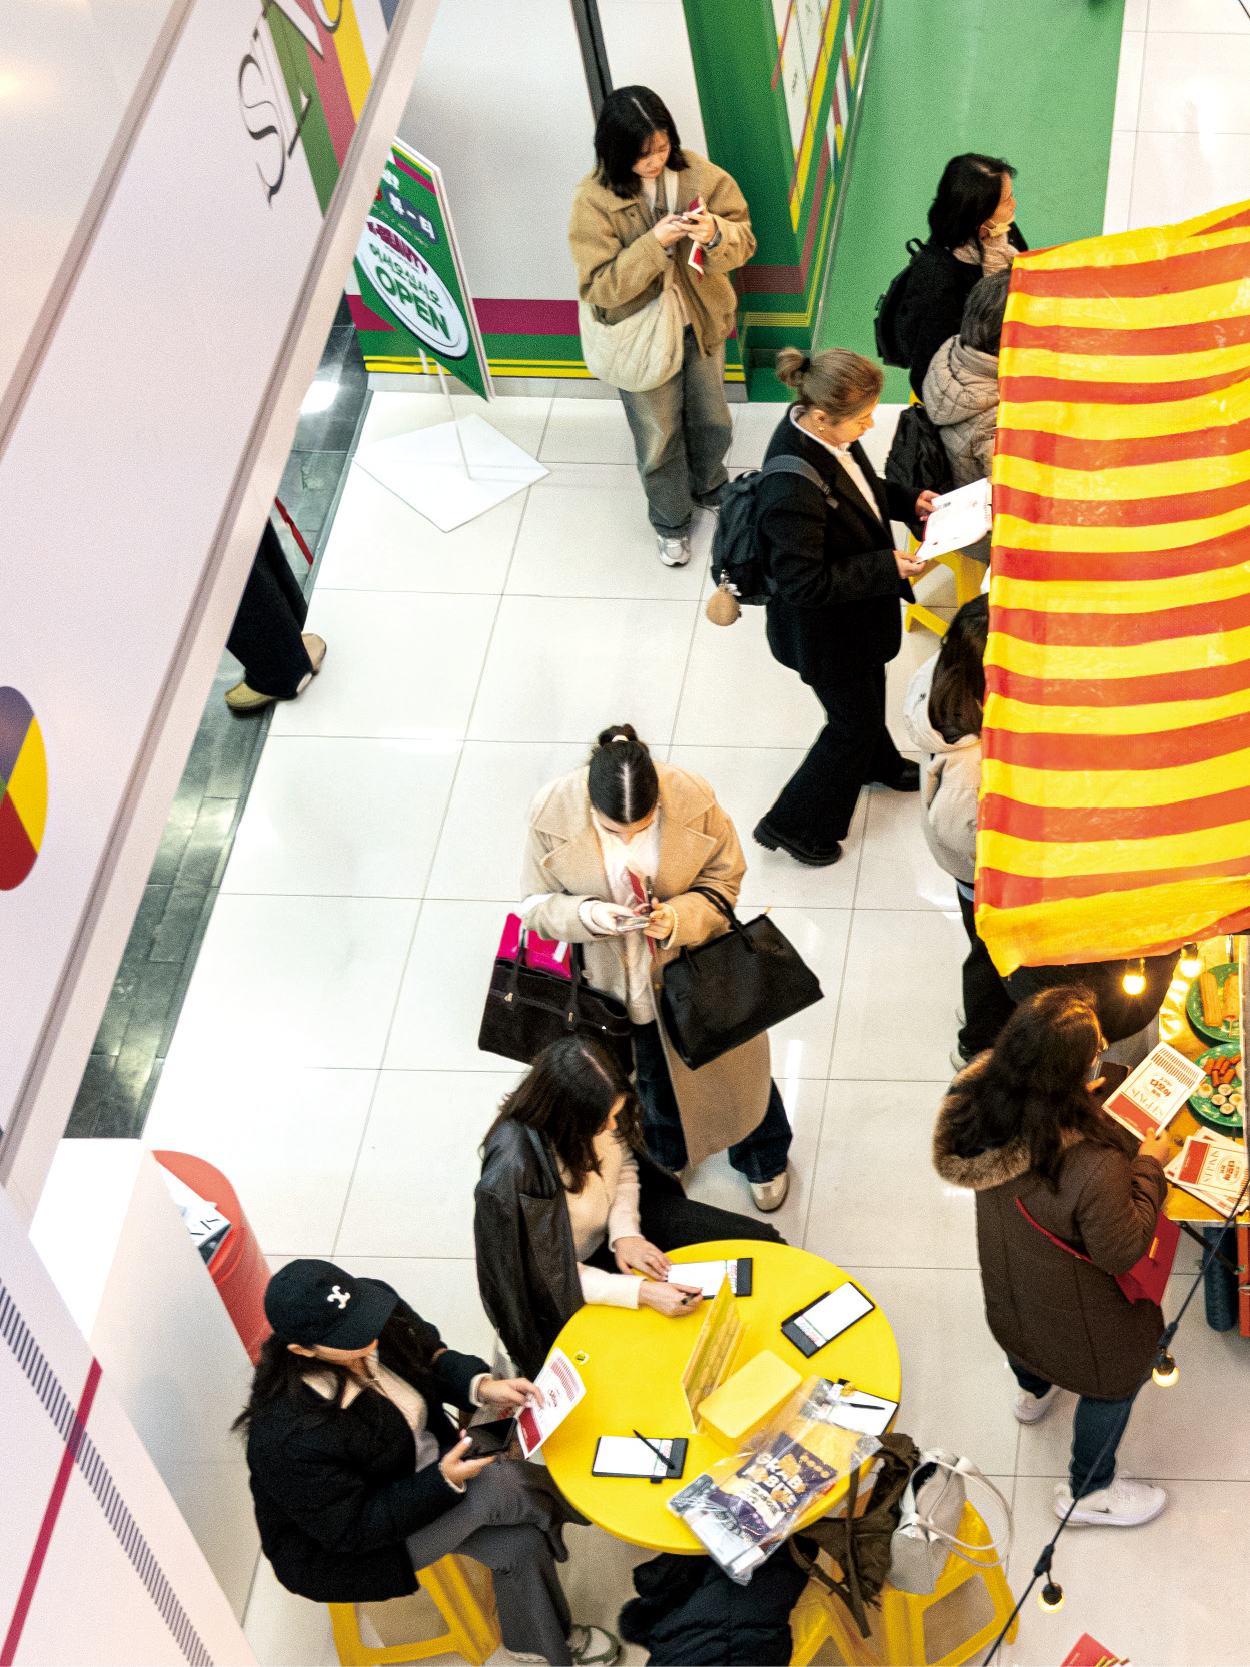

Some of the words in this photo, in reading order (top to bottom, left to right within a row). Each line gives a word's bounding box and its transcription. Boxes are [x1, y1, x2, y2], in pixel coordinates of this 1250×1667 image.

[369, 243, 443, 309] 어서오십시오
[375, 265, 451, 341] OPEN
[1128, 1087, 1163, 1119] SINGLES
